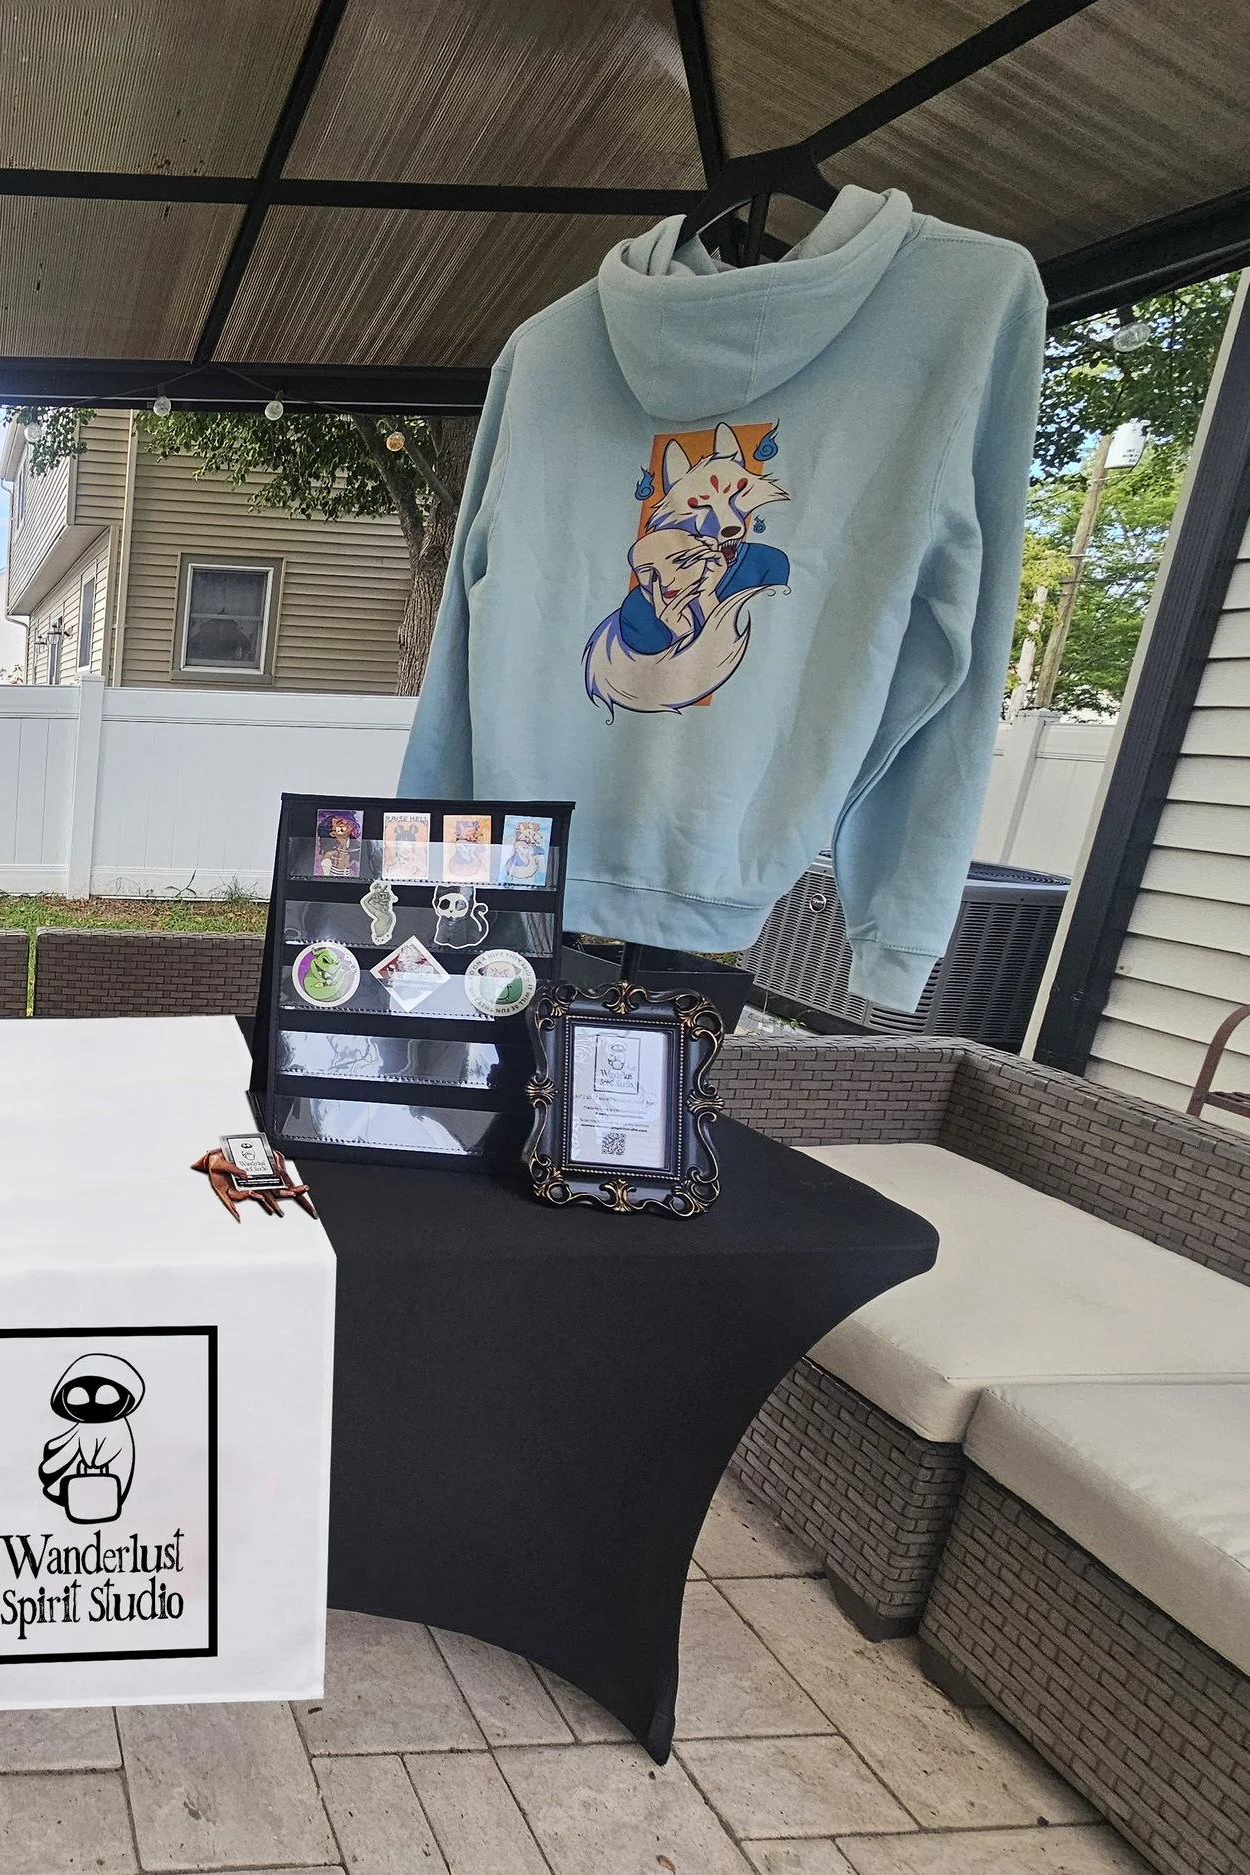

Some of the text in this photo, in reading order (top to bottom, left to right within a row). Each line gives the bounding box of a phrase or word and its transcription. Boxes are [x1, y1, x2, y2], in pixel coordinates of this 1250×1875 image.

[519, 991, 530, 1006] WILL
[0, 1575, 184, 1640] Spirit Studio
